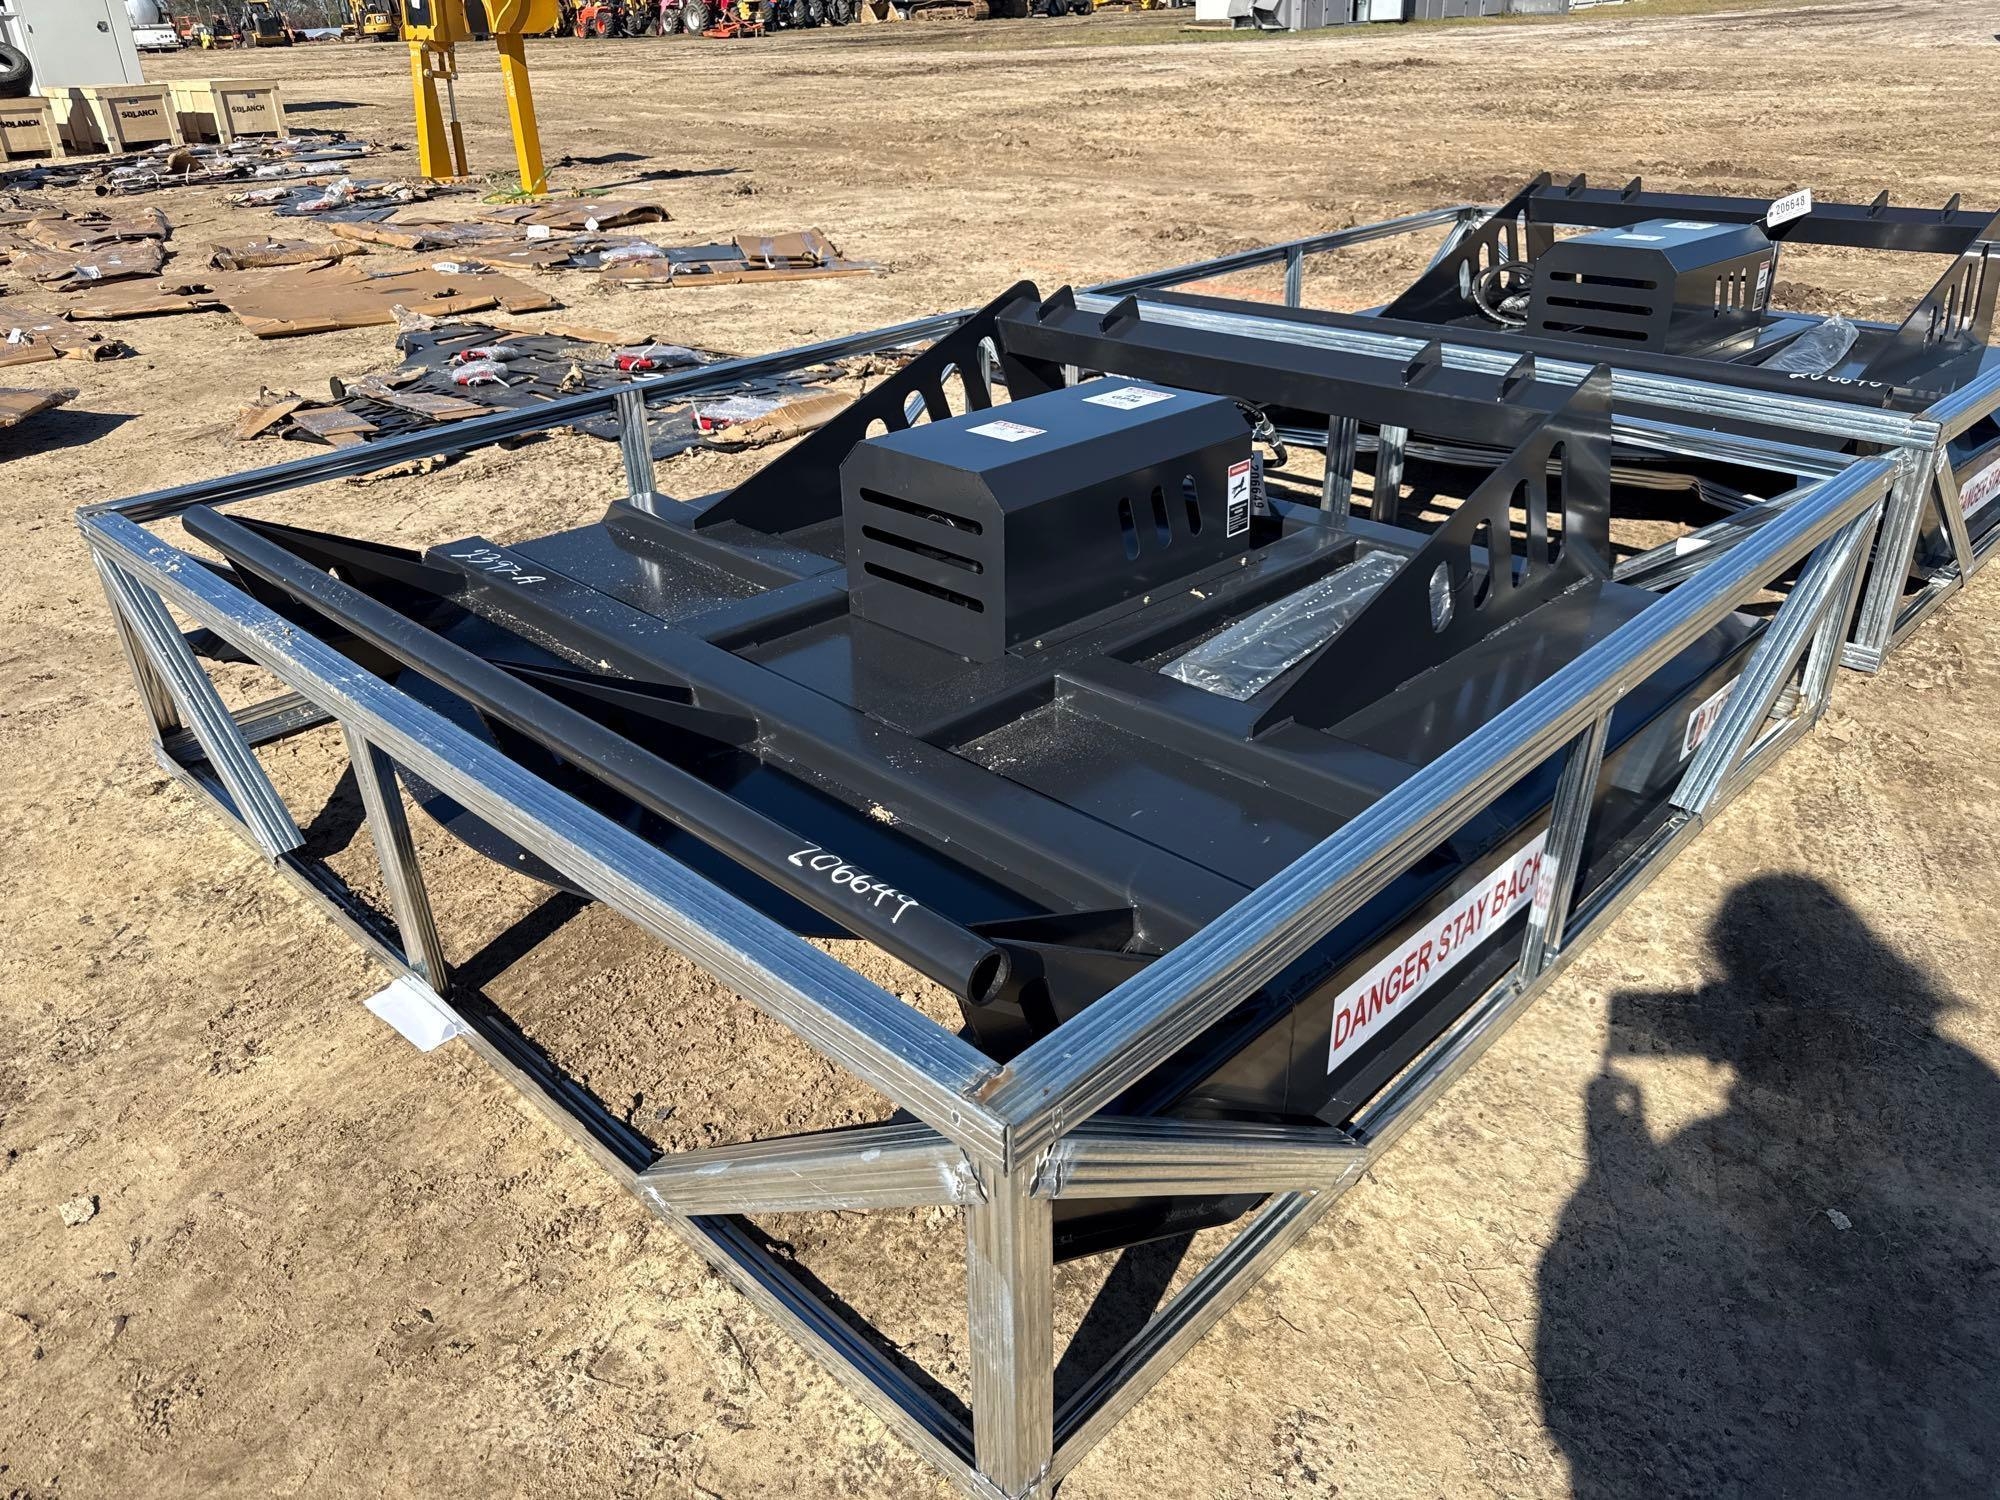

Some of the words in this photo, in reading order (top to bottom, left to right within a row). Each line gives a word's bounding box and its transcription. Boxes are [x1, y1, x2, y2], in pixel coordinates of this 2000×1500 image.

[1776, 195, 1805, 215] 206648
[1251, 464, 1264, 508] 206649
[787, 840, 919, 924] 206649
[1333, 939, 1433, 1051] DANGER
[1437, 893, 1489, 963] STAY
[1491, 851, 1543, 917] BACK
